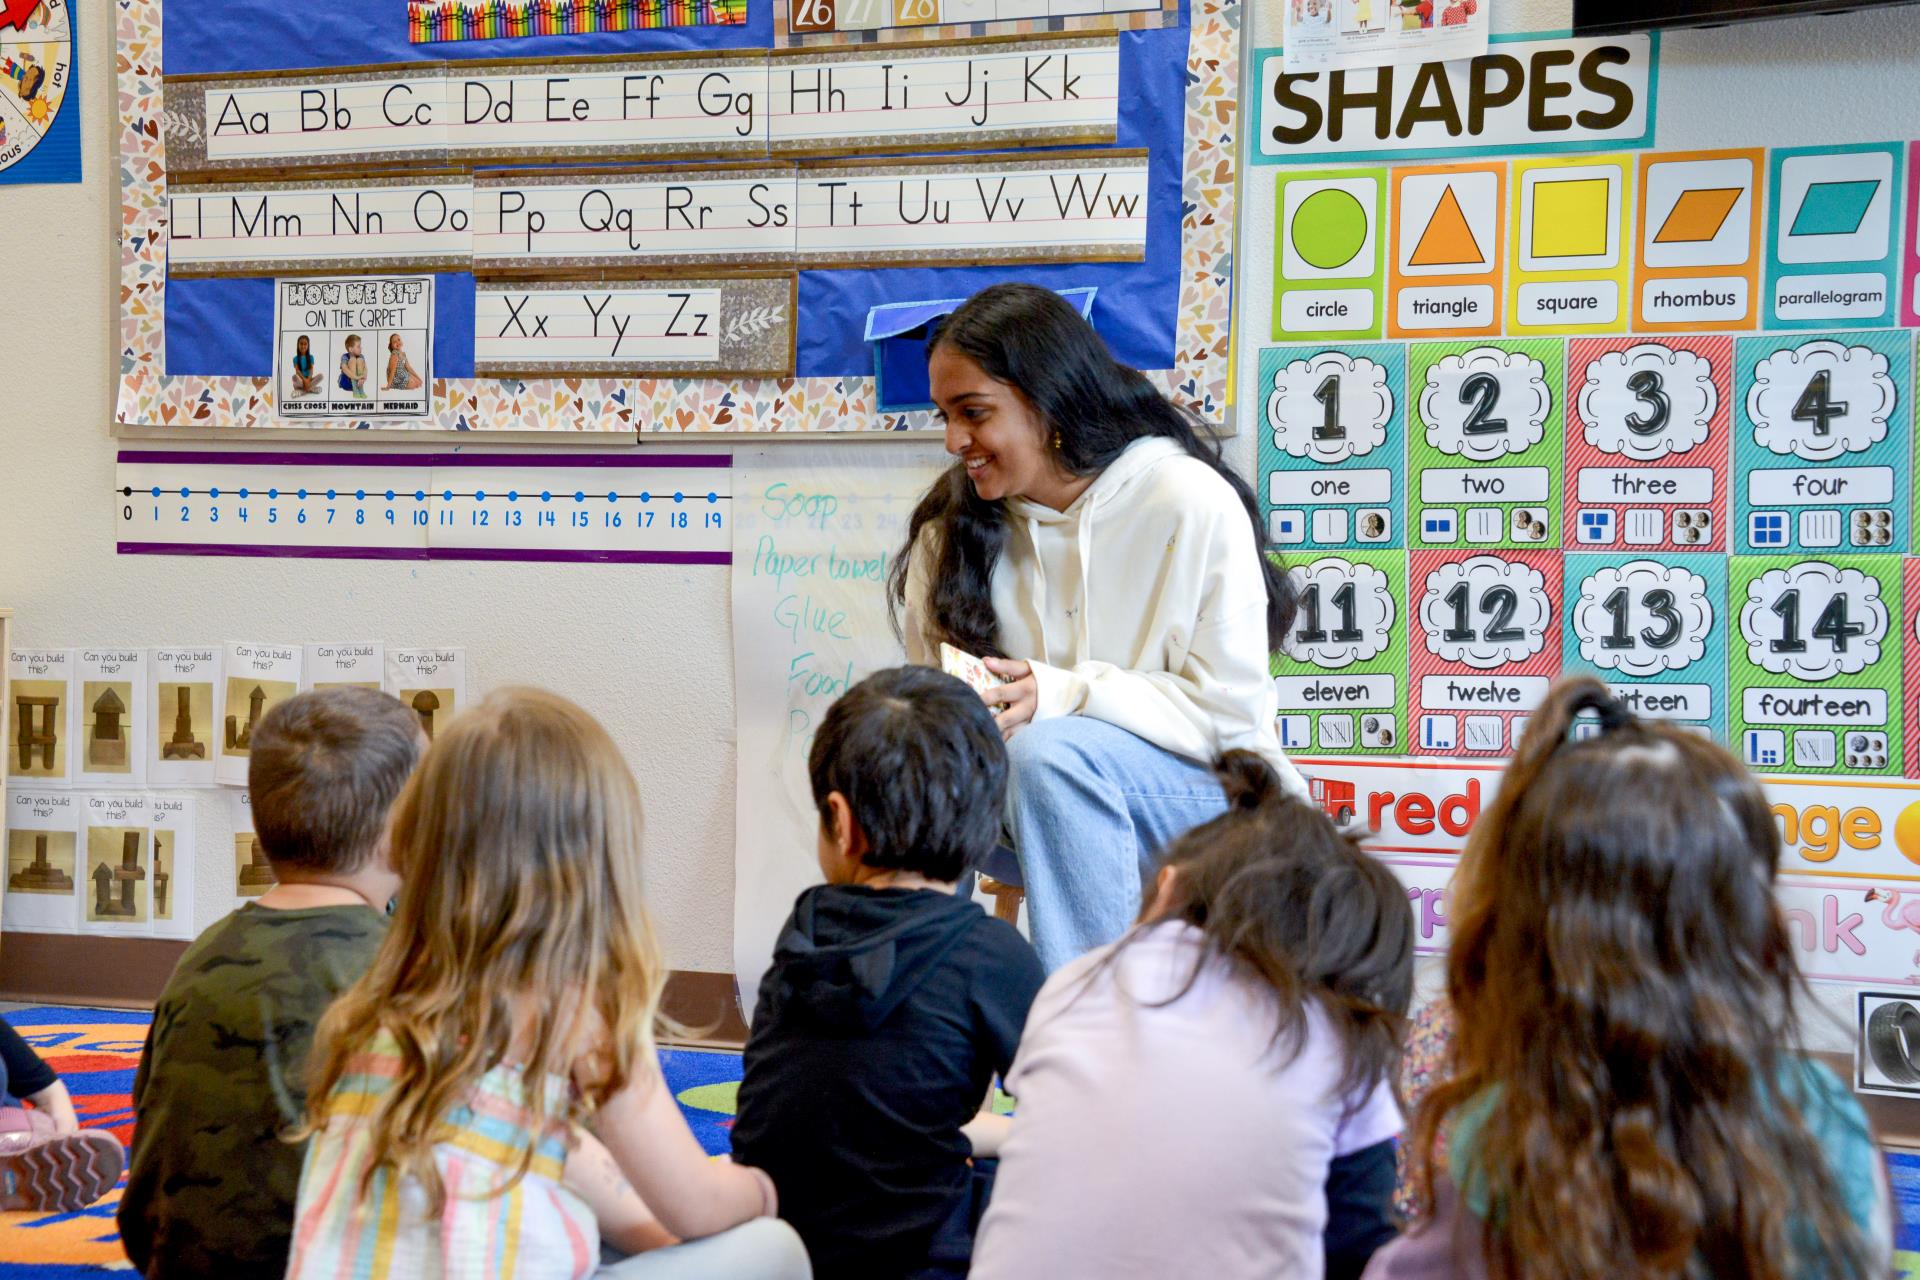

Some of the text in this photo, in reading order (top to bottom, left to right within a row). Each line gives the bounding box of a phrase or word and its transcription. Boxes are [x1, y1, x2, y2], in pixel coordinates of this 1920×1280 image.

[796, 0, 832, 26] 26
[52, 62, 67, 88] hot
[214, 54, 1080, 136] Aa Bb Cc Dd Ee Ff Gg Hh Ii Jj Kk
[1272, 46, 1634, 144] SHAPES
[0, 144, 22, 164] sno
[233, 196, 300, 237] Mm
[333, 193, 382, 234] Nn
[414, 190, 468, 232] Oo
[500, 191, 544, 252] Pp
[580, 190, 640, 250] Qq
[666, 186, 712, 230] Rr
[748, 184, 788, 227] Ss
[818, 182, 862, 226] Tt
[900, 179, 950, 224] Uu
[976, 177, 1024, 222] Vv
[1050, 173, 1138, 219] Ww
[289, 282, 422, 306] HOW WE SIT
[1536, 294, 1598, 313] square
[1654, 290, 1736, 307] rhombus
[1778, 290, 1882, 307] parallelogram
[1306, 302, 1348, 318] circle
[1413, 298, 1478, 318] triangle
[306, 310, 326, 328] ON
[332, 310, 354, 328] THE
[499, 294, 708, 356] Xx Yy Zz
[304, 402, 327, 410] CROSS
[384, 402, 418, 410] MERMAID
[1312, 374, 1346, 440] 1
[1459, 372, 1508, 436] 2
[1625, 370, 1670, 436] 3
[1791, 369, 1848, 436] 4
[1311, 479, 1350, 496] one
[1462, 473, 1504, 494] two
[1612, 472, 1677, 495] three
[1792, 474, 1848, 496] four
[761, 482, 838, 530] Soap
[124, 506, 132, 520] 0
[154, 506, 158, 520] 1
[181, 506, 190, 522] 2
[210, 506, 218, 522] 3
[239, 508, 248, 522] 4
[268, 508, 277, 524] 5
[298, 508, 306, 524] 6
[326, 509, 335, 524] 7
[356, 509, 364, 524] 8
[386, 510, 394, 525] 9
[413, 510, 428, 526] 10
[440, 510, 453, 526] 11
[472, 510, 488, 526] 12
[506, 511, 522, 526] 13
[538, 512, 556, 526] 14
[572, 512, 588, 527] 15
[605, 512, 622, 528] 16
[638, 512, 654, 528] 17
[671, 512, 688, 528] 18
[705, 512, 722, 528] 19
[753, 535, 824, 592] Paper
[774, 595, 852, 644] Glue
[1296, 582, 1363, 642] 11
[1444, 582, 1525, 642] 12
[1600, 586, 1683, 648] 13
[1770, 588, 1864, 652] 14
[11, 652, 64, 664] Can you build
[84, 652, 138, 663] Can you build
[158, 651, 212, 662] Can you build
[237, 646, 292, 660] Can you build
[318, 646, 373, 658] Can you build
[398, 652, 454, 664] Can you build
[28, 664, 48, 674] this?
[100, 664, 120, 674] this?
[174, 663, 195, 673] this?
[252, 660, 274, 670] this?
[336, 658, 356, 669] this?
[416, 664, 438, 675] this?
[788, 652, 853, 697] Food
[1302, 680, 1369, 702] eleven
[1447, 682, 1520, 702] twelve
[1619, 689, 1688, 711] irteen
[1758, 694, 1870, 717] fourteen
[16, 796, 70, 806] Can you build
[89, 798, 143, 809] Can you build
[164, 801, 182, 810] build
[1368, 778, 1481, 837] red
[32, 808, 54, 818] this?
[106, 810, 127, 820] this?
[154, 812, 166, 822] is?
[1770, 803, 1882, 862] nge
[1787, 894, 1866, 956] nk
